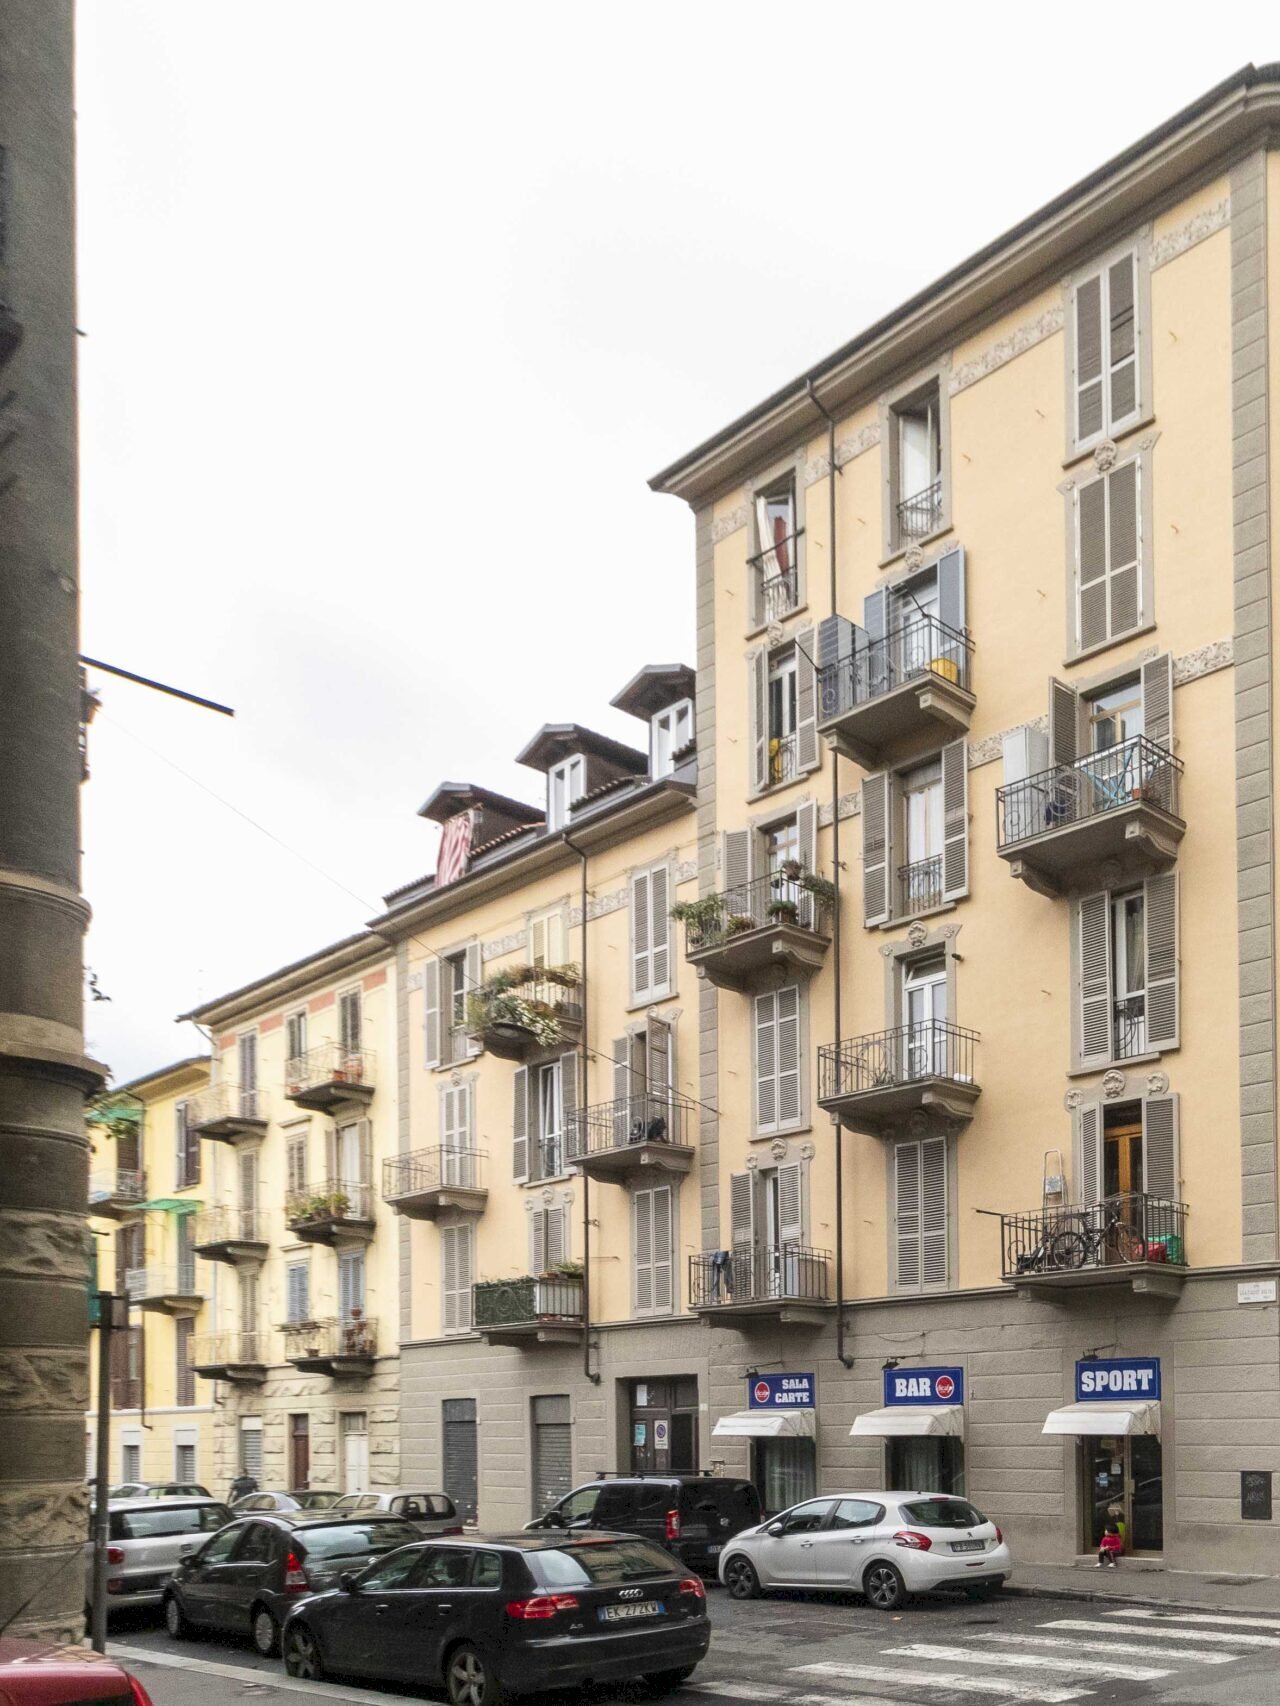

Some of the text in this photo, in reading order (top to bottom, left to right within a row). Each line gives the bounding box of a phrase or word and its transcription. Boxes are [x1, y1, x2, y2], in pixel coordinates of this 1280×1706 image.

[782, 1378, 809, 1389] SALA
[1081, 1369, 1153, 1392] SPORT
[895, 1377, 931, 1397] BAR
[775, 1392, 809, 1403] CARTE
[607, 1608, 620, 1618] EK
